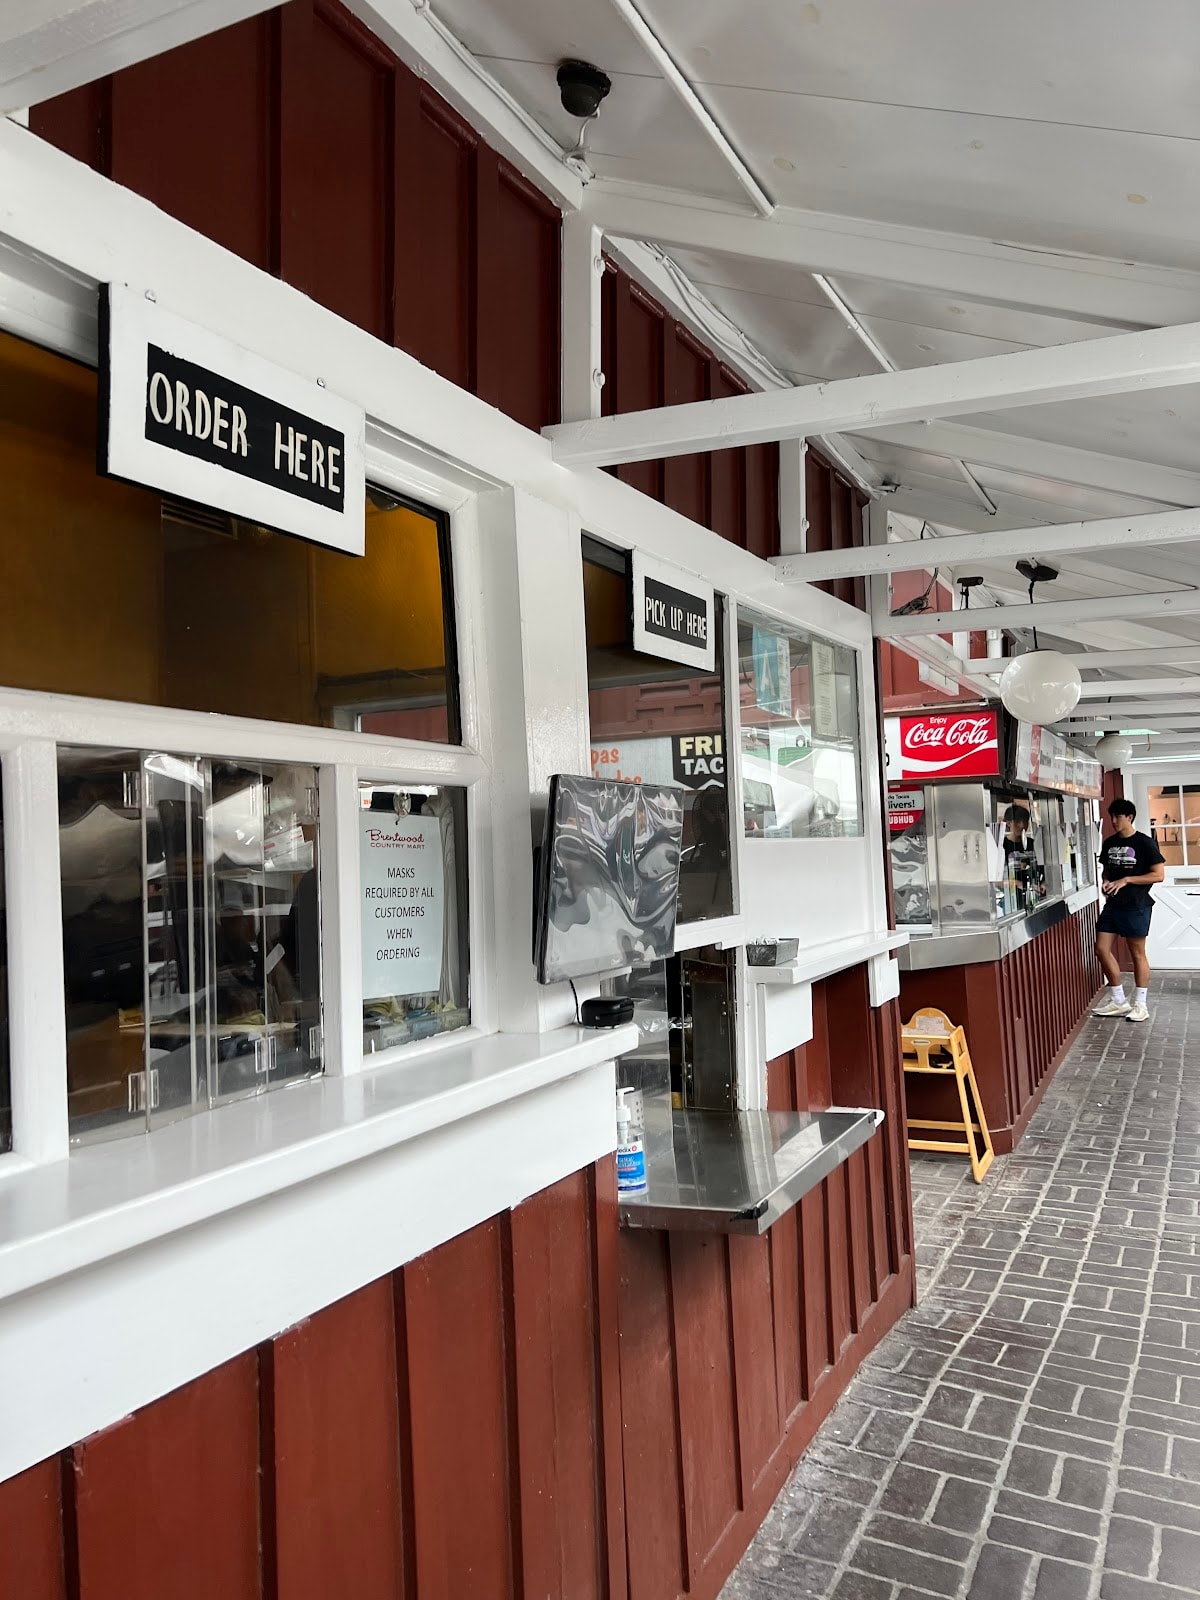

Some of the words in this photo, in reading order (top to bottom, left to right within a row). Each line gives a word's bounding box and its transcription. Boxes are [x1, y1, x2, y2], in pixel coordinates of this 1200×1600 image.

[149, 372, 248, 457] ORDER
[274, 422, 341, 493] HERE
[645, 596, 666, 628] PICK
[670, 606, 684, 632] UP
[687, 612, 707, 640] HERE
[930, 716, 947, 724] Enjoy
[905, 723, 945, 748] Coca
[945, 718, 991, 746] Cola
[679, 735, 722, 757] FRI
[681, 757, 725, 776] TAC
[365, 828, 425, 843] Brentwood
[387, 867, 416, 878] MASKS
[365, 887, 408, 899] REQUIRED
[409, 887, 420, 898] BY
[421, 887, 435, 898] ALL
[374, 906, 425, 918] CUSTOMERS
[387, 928, 413, 940] WHEN
[376, 946, 420, 961] ORDERING
